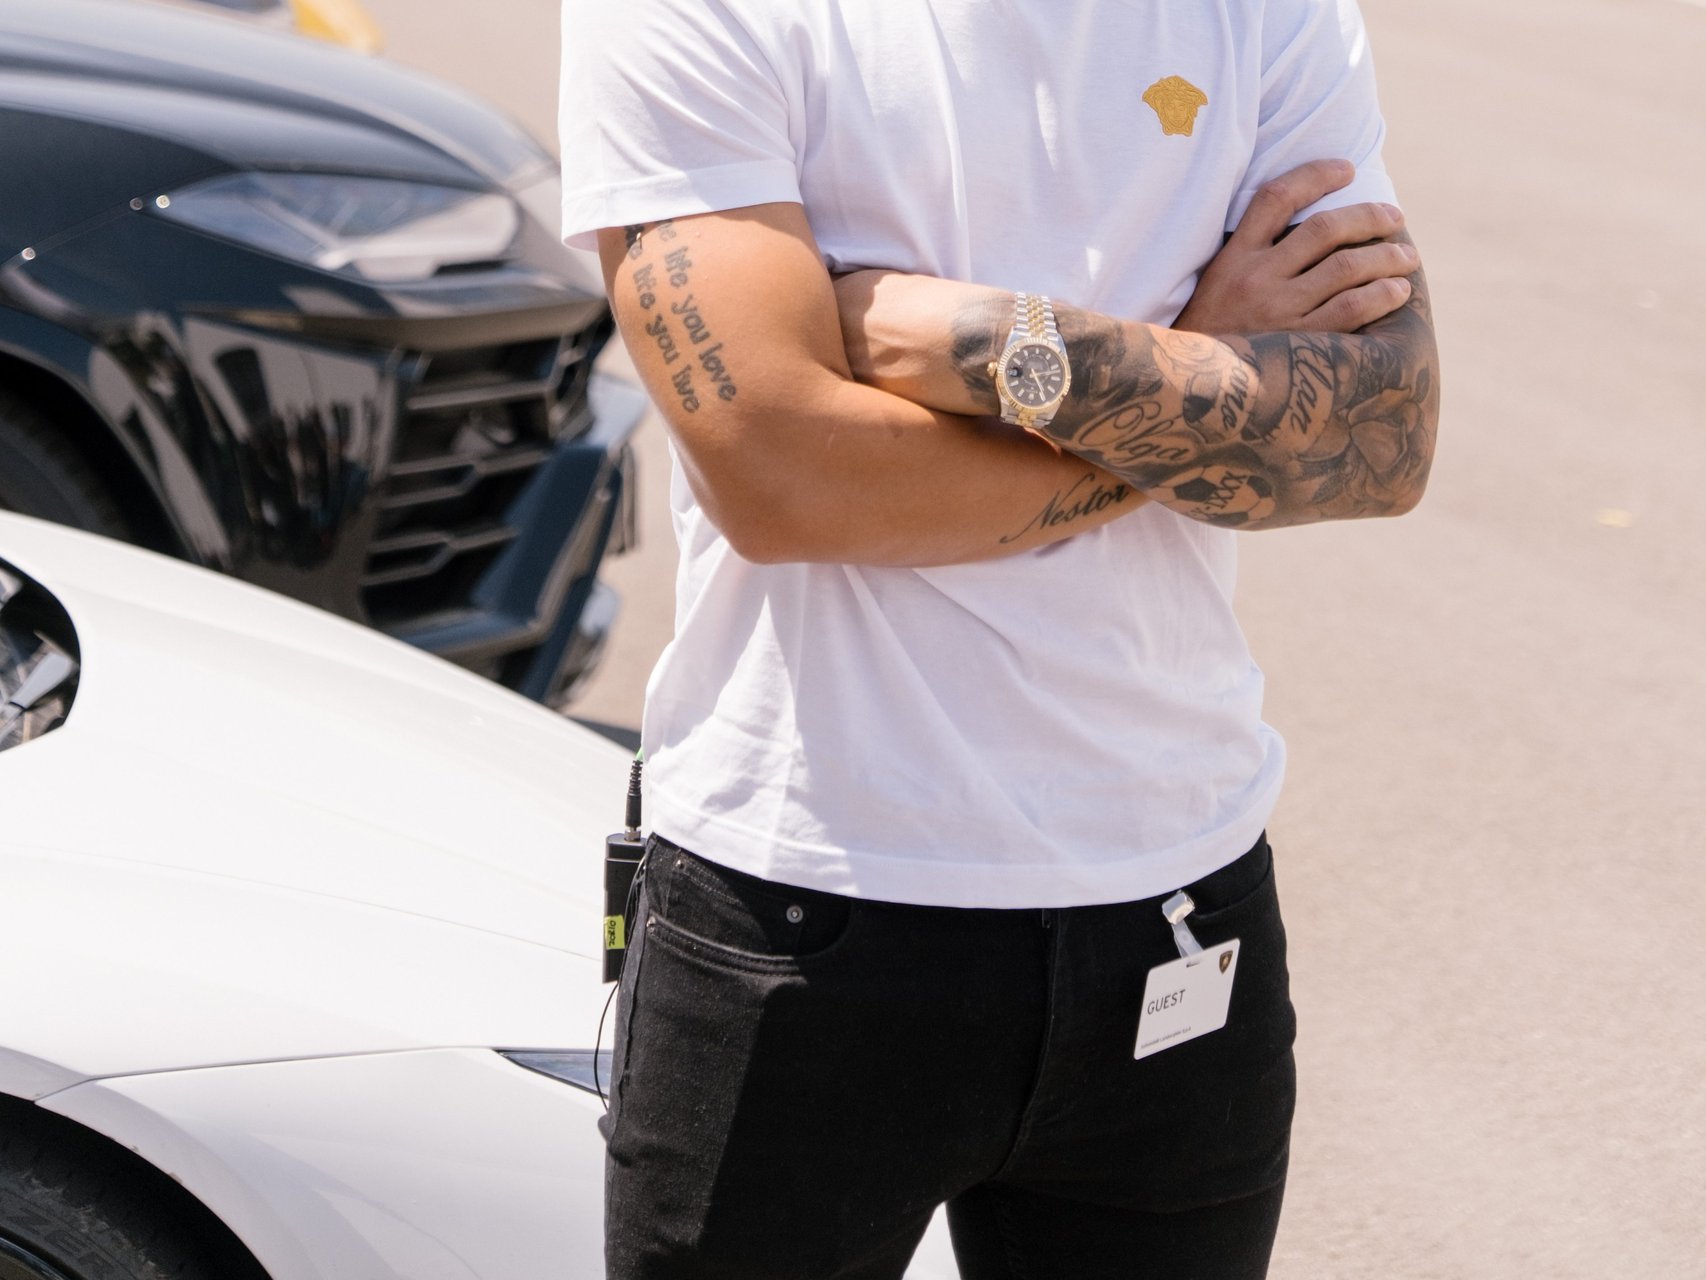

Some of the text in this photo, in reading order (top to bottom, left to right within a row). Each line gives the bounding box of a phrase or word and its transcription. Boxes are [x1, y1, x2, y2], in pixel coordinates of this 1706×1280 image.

[664, 245, 692, 288] life
[633, 262, 657, 311] life
[645, 313, 680, 365] you
[672, 363, 701, 414] live
[671, 293, 711, 345] you
[698, 342, 737, 402] love
[1079, 400, 1189, 464] Olga
[999, 472, 1129, 544] Nestor
[1147, 988, 1186, 1015] GUEST
